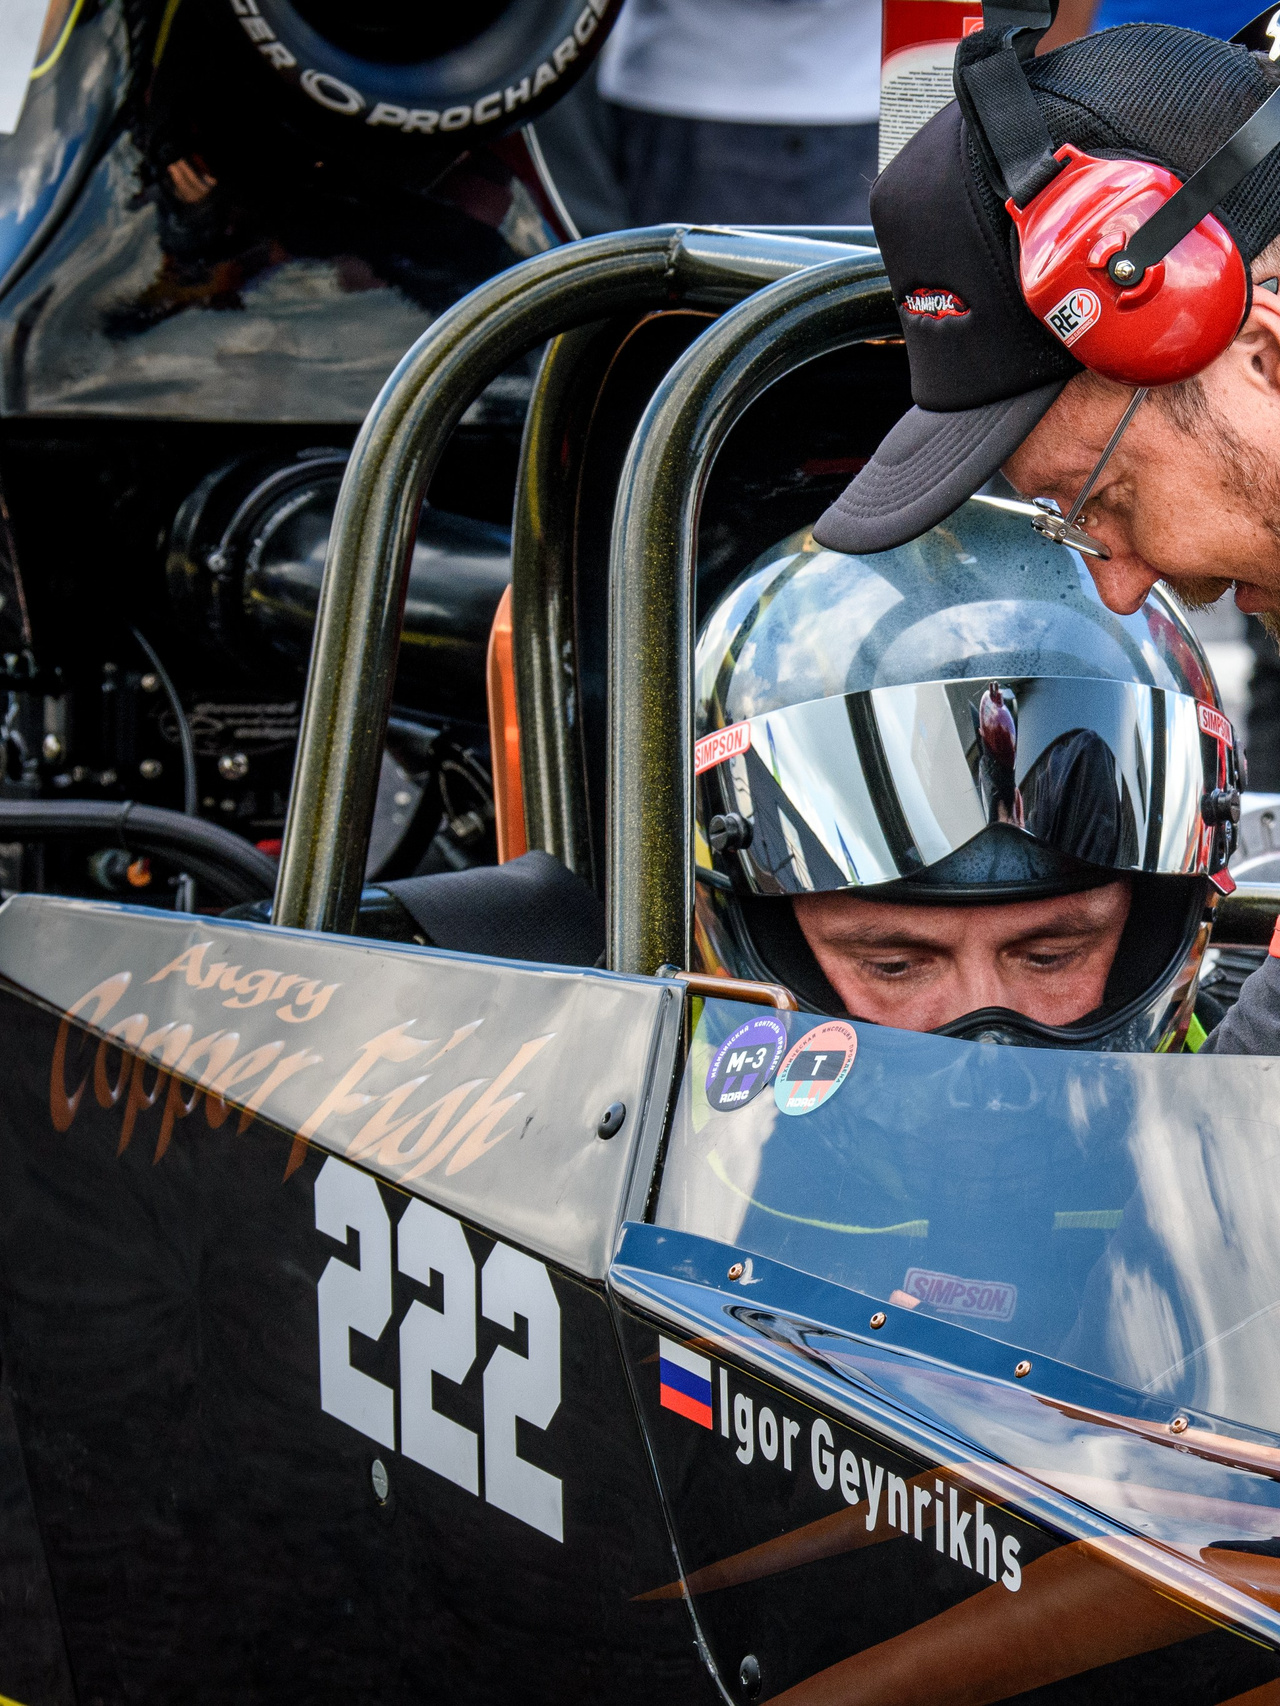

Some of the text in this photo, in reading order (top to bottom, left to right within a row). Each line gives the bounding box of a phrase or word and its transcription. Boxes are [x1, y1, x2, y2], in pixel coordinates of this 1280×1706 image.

[695, 728, 743, 769] SIMPSON
[144, 941, 342, 1023] Angry
[50, 971, 558, 1184] Copper Fish
[314, 1155, 563, 1543] 222
[910, 1276, 1009, 1313] SIMPSON
[719, 1367, 1022, 1593] Igor Geynrikhs
